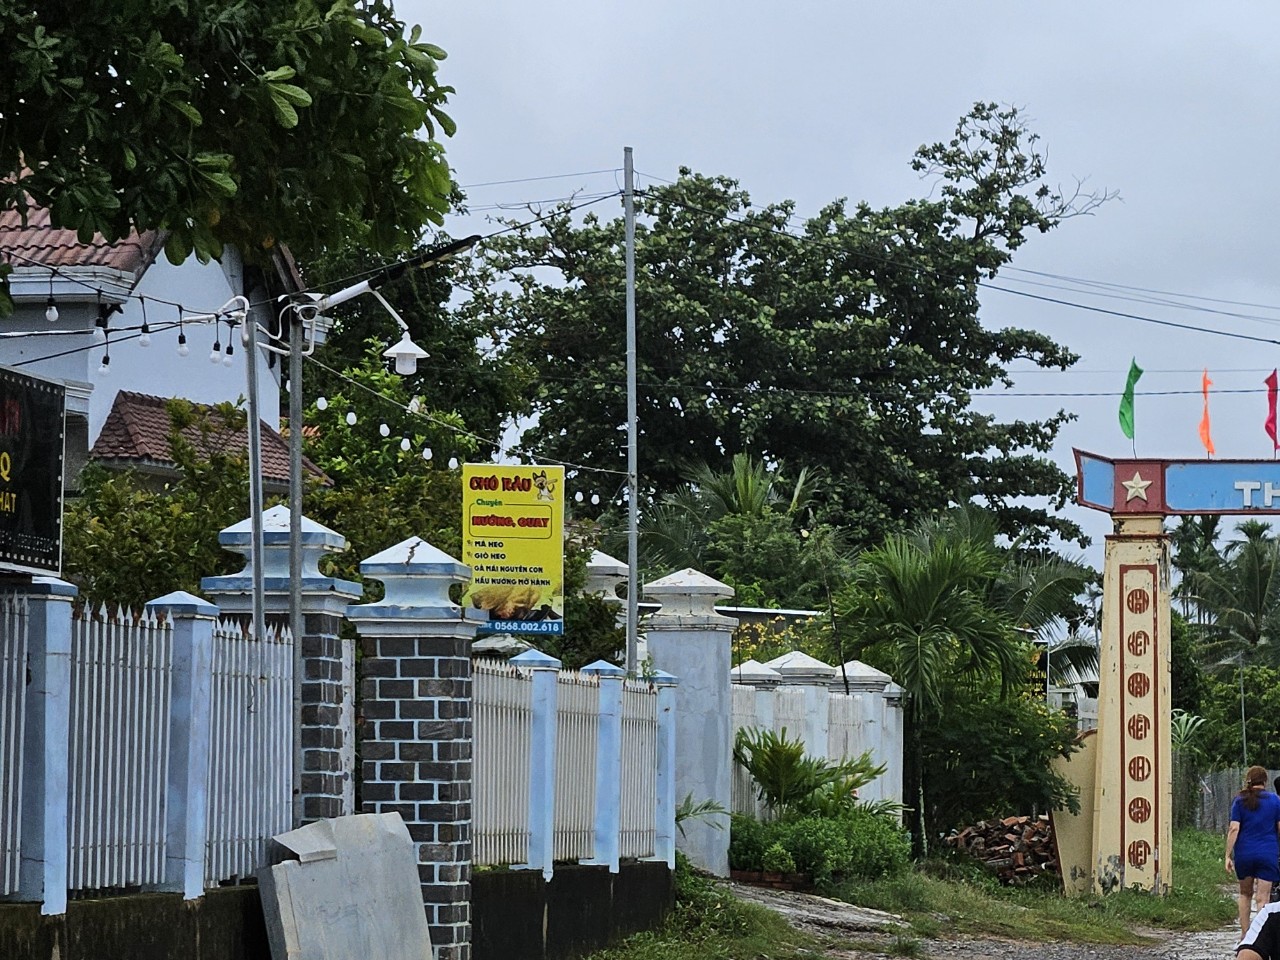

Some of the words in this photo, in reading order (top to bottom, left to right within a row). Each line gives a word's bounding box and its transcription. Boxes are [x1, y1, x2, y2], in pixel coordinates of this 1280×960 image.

[470, 475, 499, 491] CHÓ
[517, 517, 549, 527] QUAY
[494, 621, 559, 632] 0568.002.618
